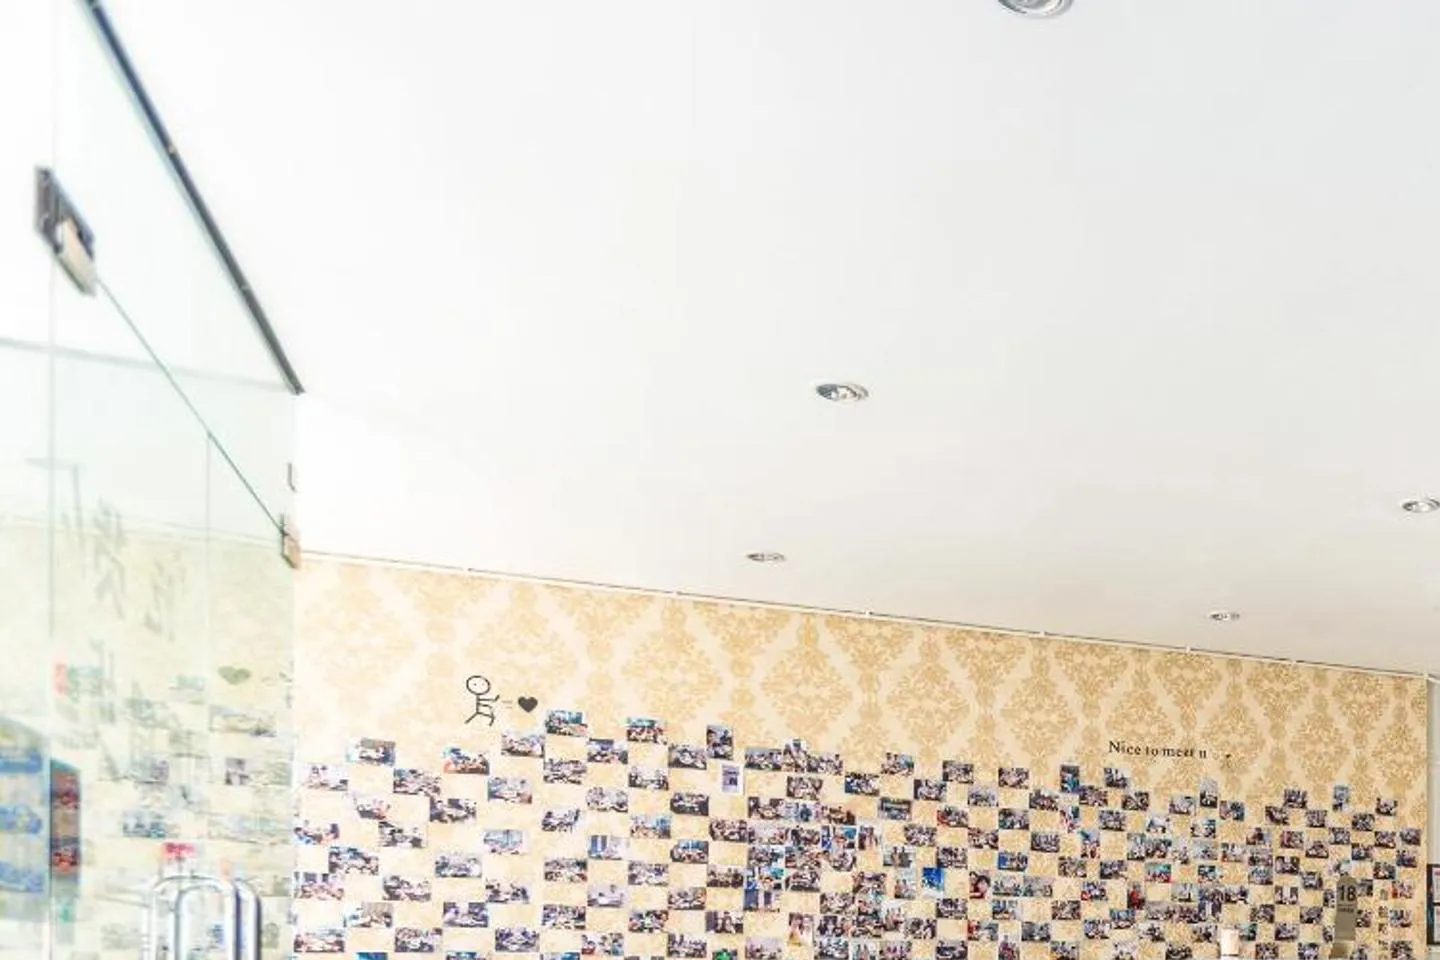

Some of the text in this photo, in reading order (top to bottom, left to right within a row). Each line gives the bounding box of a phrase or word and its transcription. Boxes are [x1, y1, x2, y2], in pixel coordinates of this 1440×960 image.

[1108, 740, 1141, 756] Nice
[1145, 746, 1159, 758] to
[1162, 748, 1194, 758] meet
[1341, 885, 1356, 901] 18
